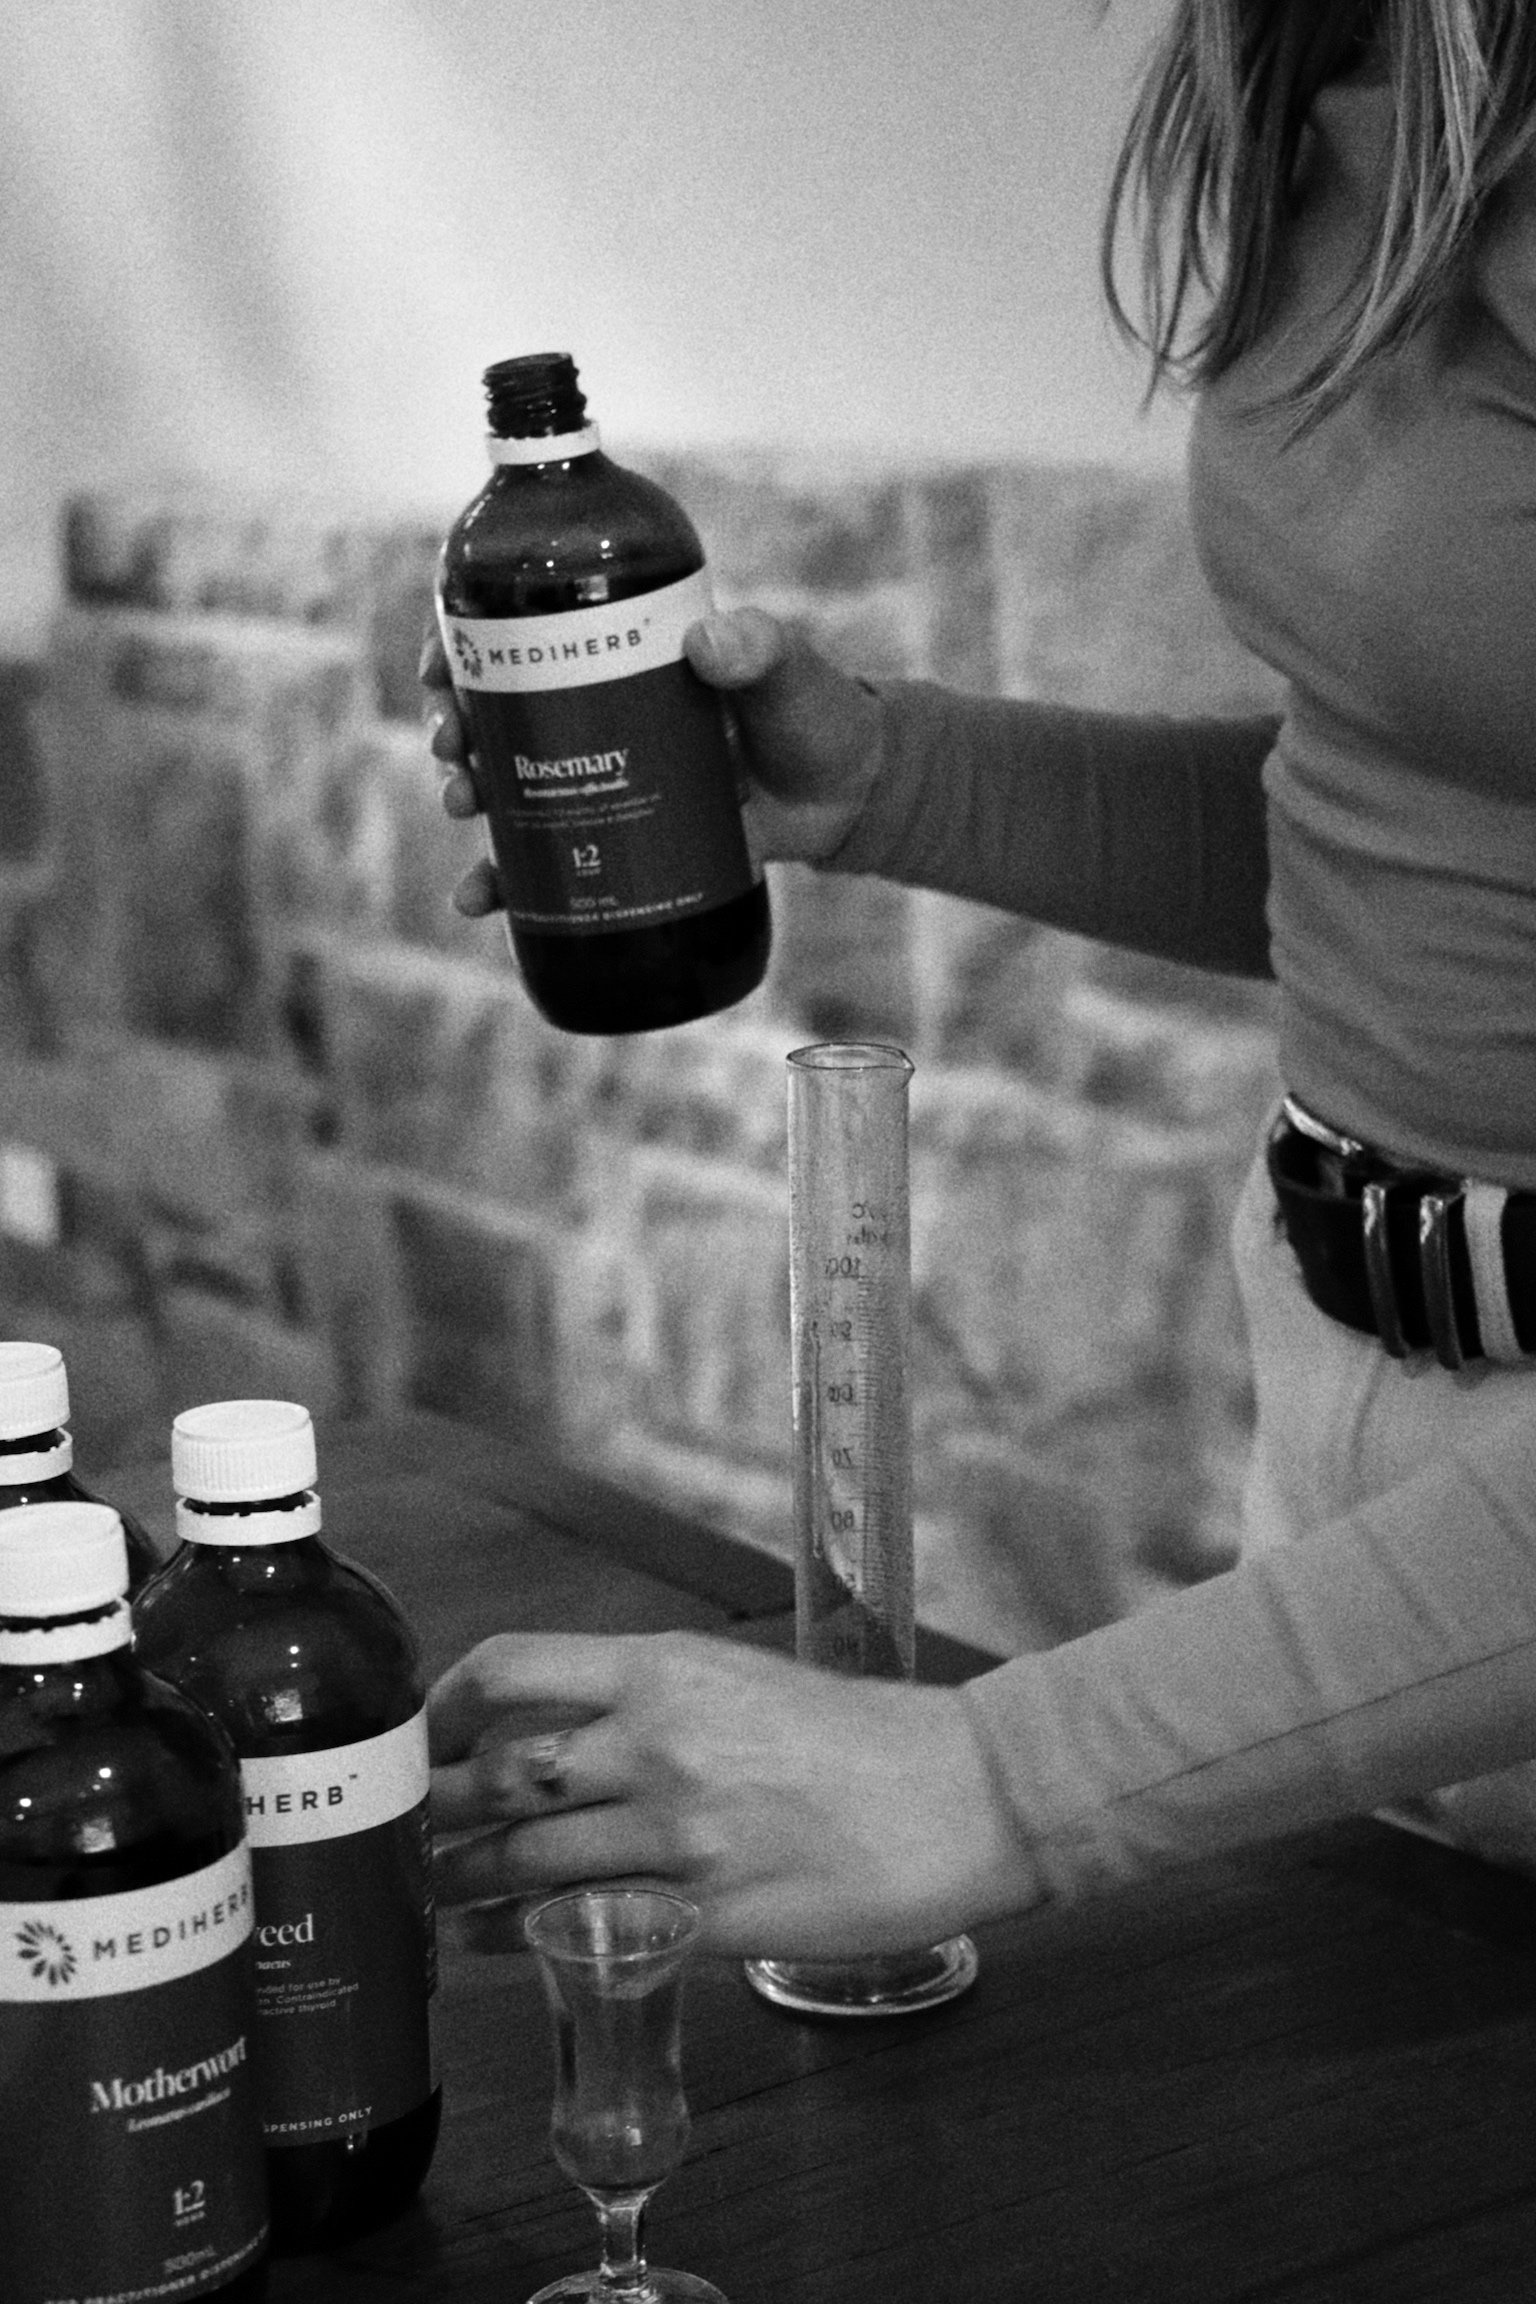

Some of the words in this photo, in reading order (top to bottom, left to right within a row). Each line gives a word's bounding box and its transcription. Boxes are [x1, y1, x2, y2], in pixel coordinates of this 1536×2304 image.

[488, 628, 642, 665] MEDIHERB
[513, 748, 630, 781] Rosemary
[245, 1784, 344, 1816] HERB
[256, 1912, 315, 1947] eed
[338, 2105, 372, 2123] ONLY
